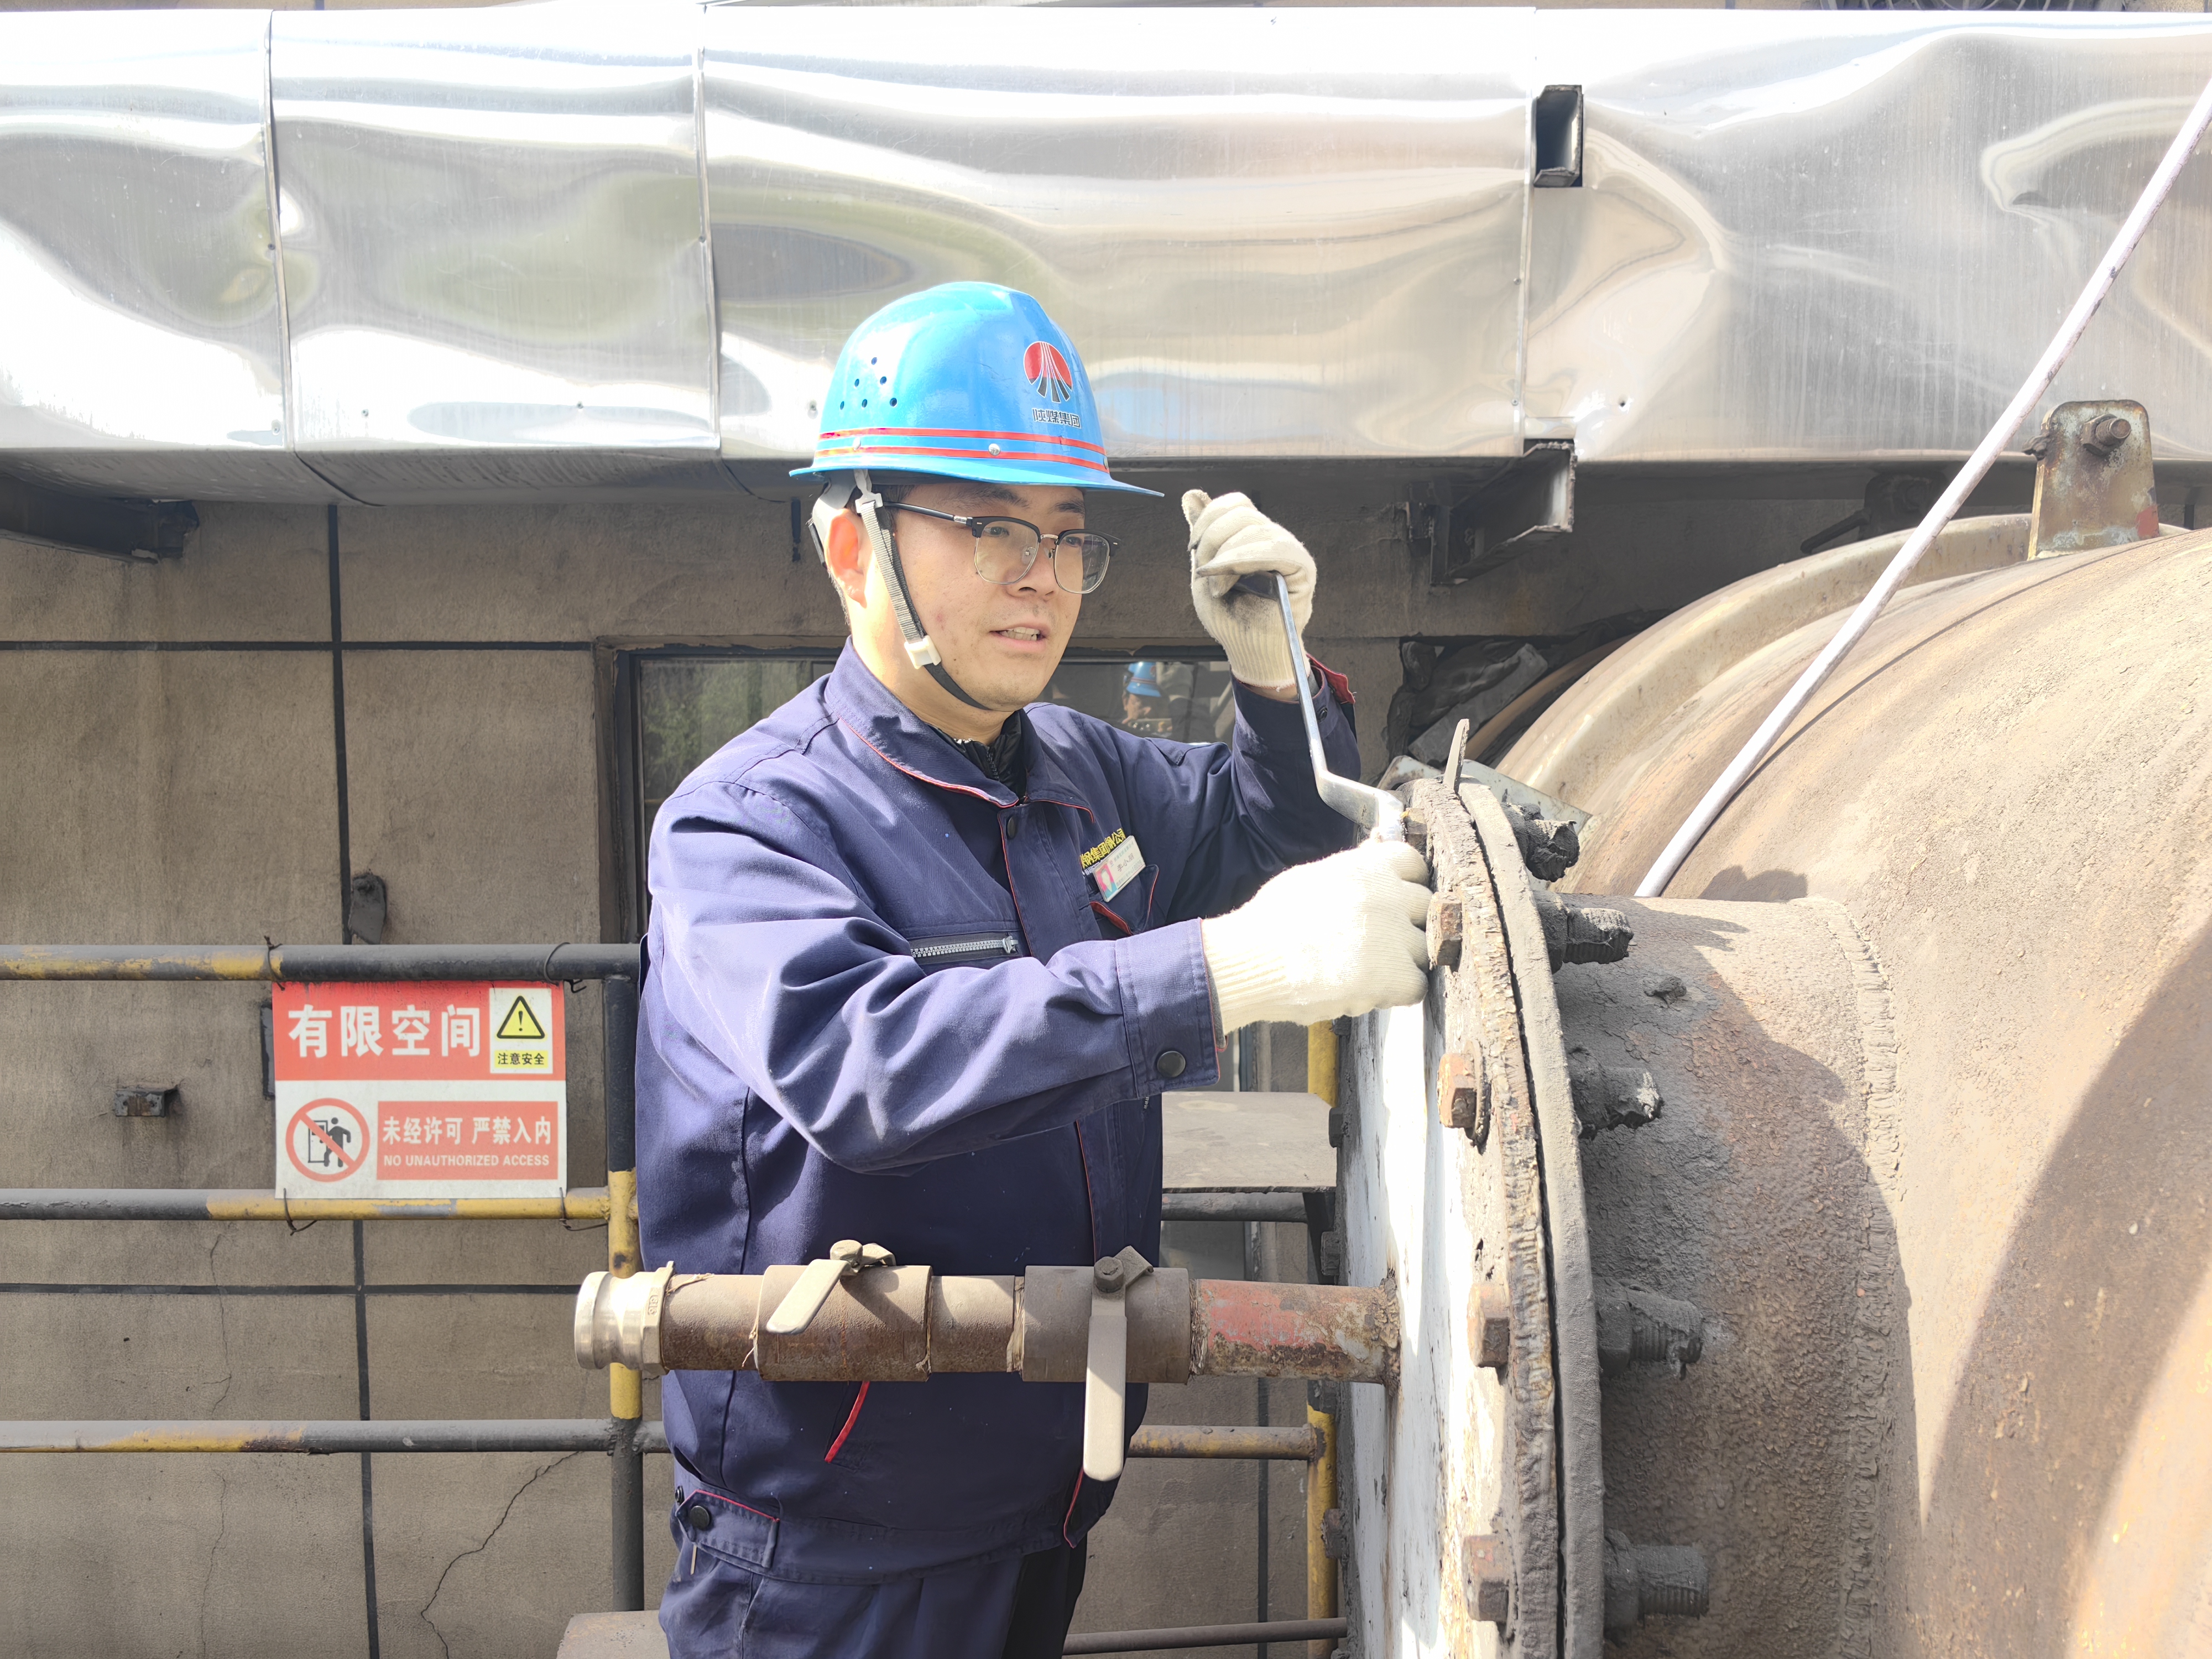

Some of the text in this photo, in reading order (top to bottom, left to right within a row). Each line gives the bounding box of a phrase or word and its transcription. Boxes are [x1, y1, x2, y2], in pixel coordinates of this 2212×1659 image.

[1032, 408, 1081, 429] 陕煤集团
[288, 1004, 481, 1058] 有限空间
[498, 1052, 545, 1065] 注意安全
[383, 1116, 551, 1145] 未经许可 严禁入内
[384, 1155, 549, 1166] NO UNAUTHORIZED ACCESS
